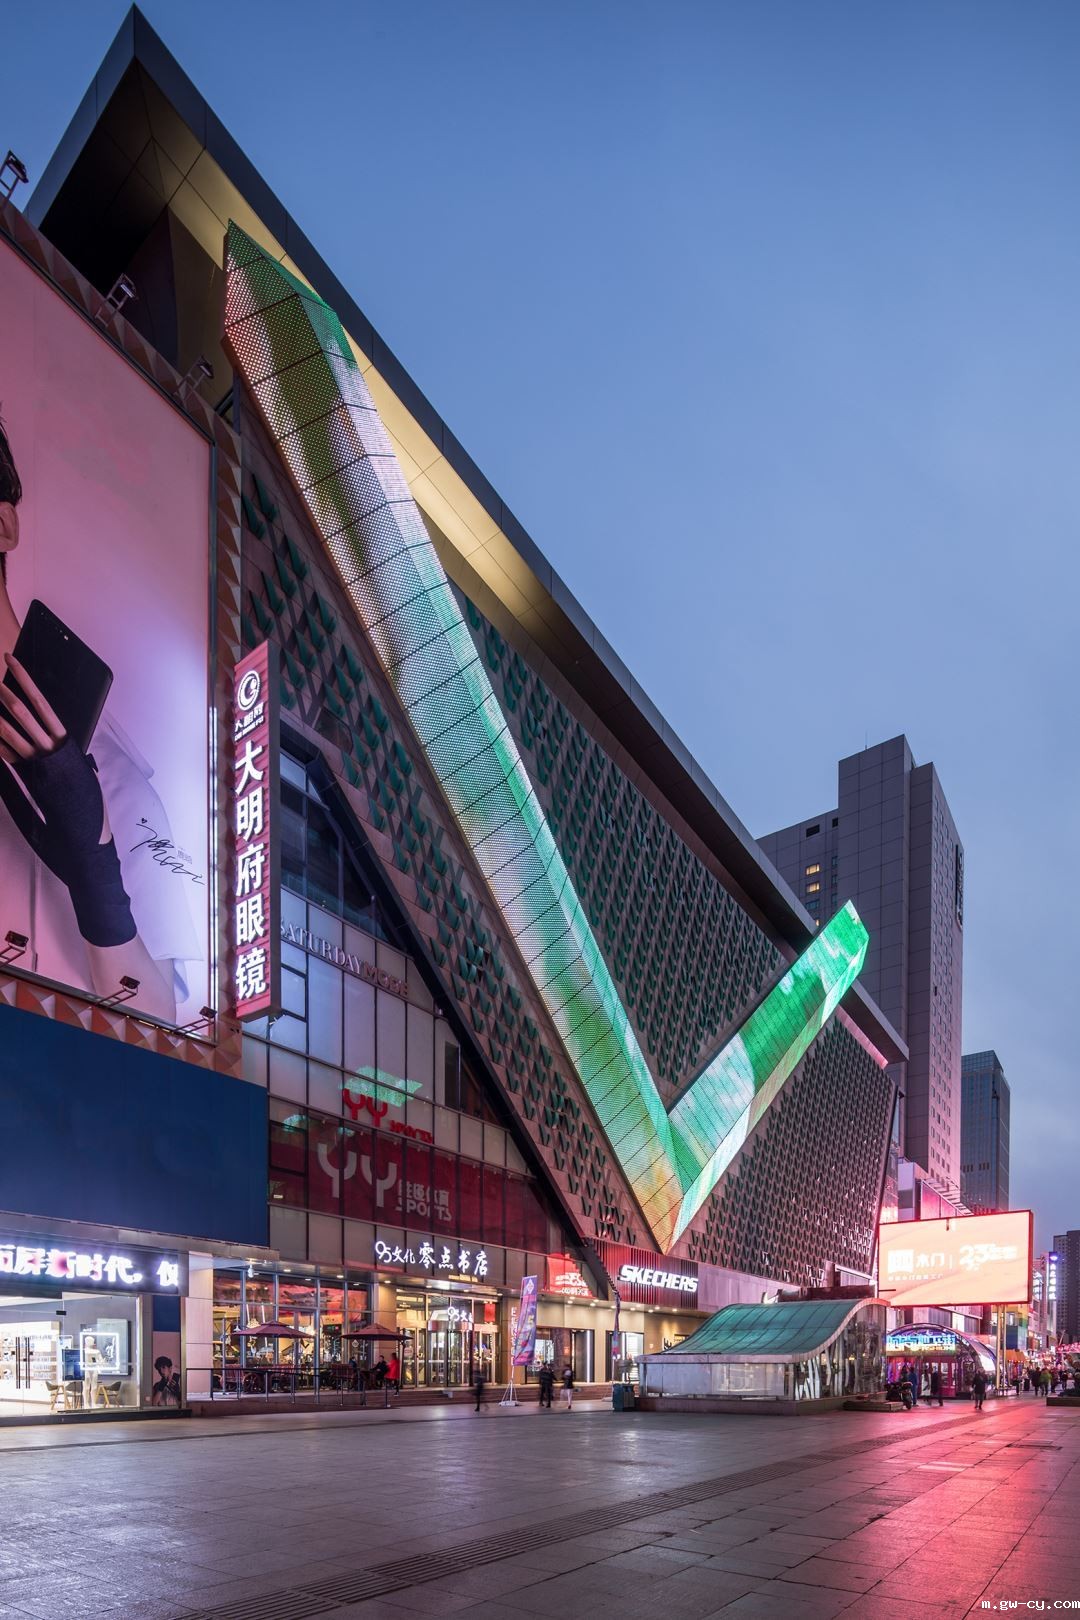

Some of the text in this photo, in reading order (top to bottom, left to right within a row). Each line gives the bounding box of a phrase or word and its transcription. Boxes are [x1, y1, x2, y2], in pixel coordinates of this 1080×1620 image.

[234, 739, 266, 1002] 大明府眼镜
[618, 1264, 700, 1293] SKECHERS
